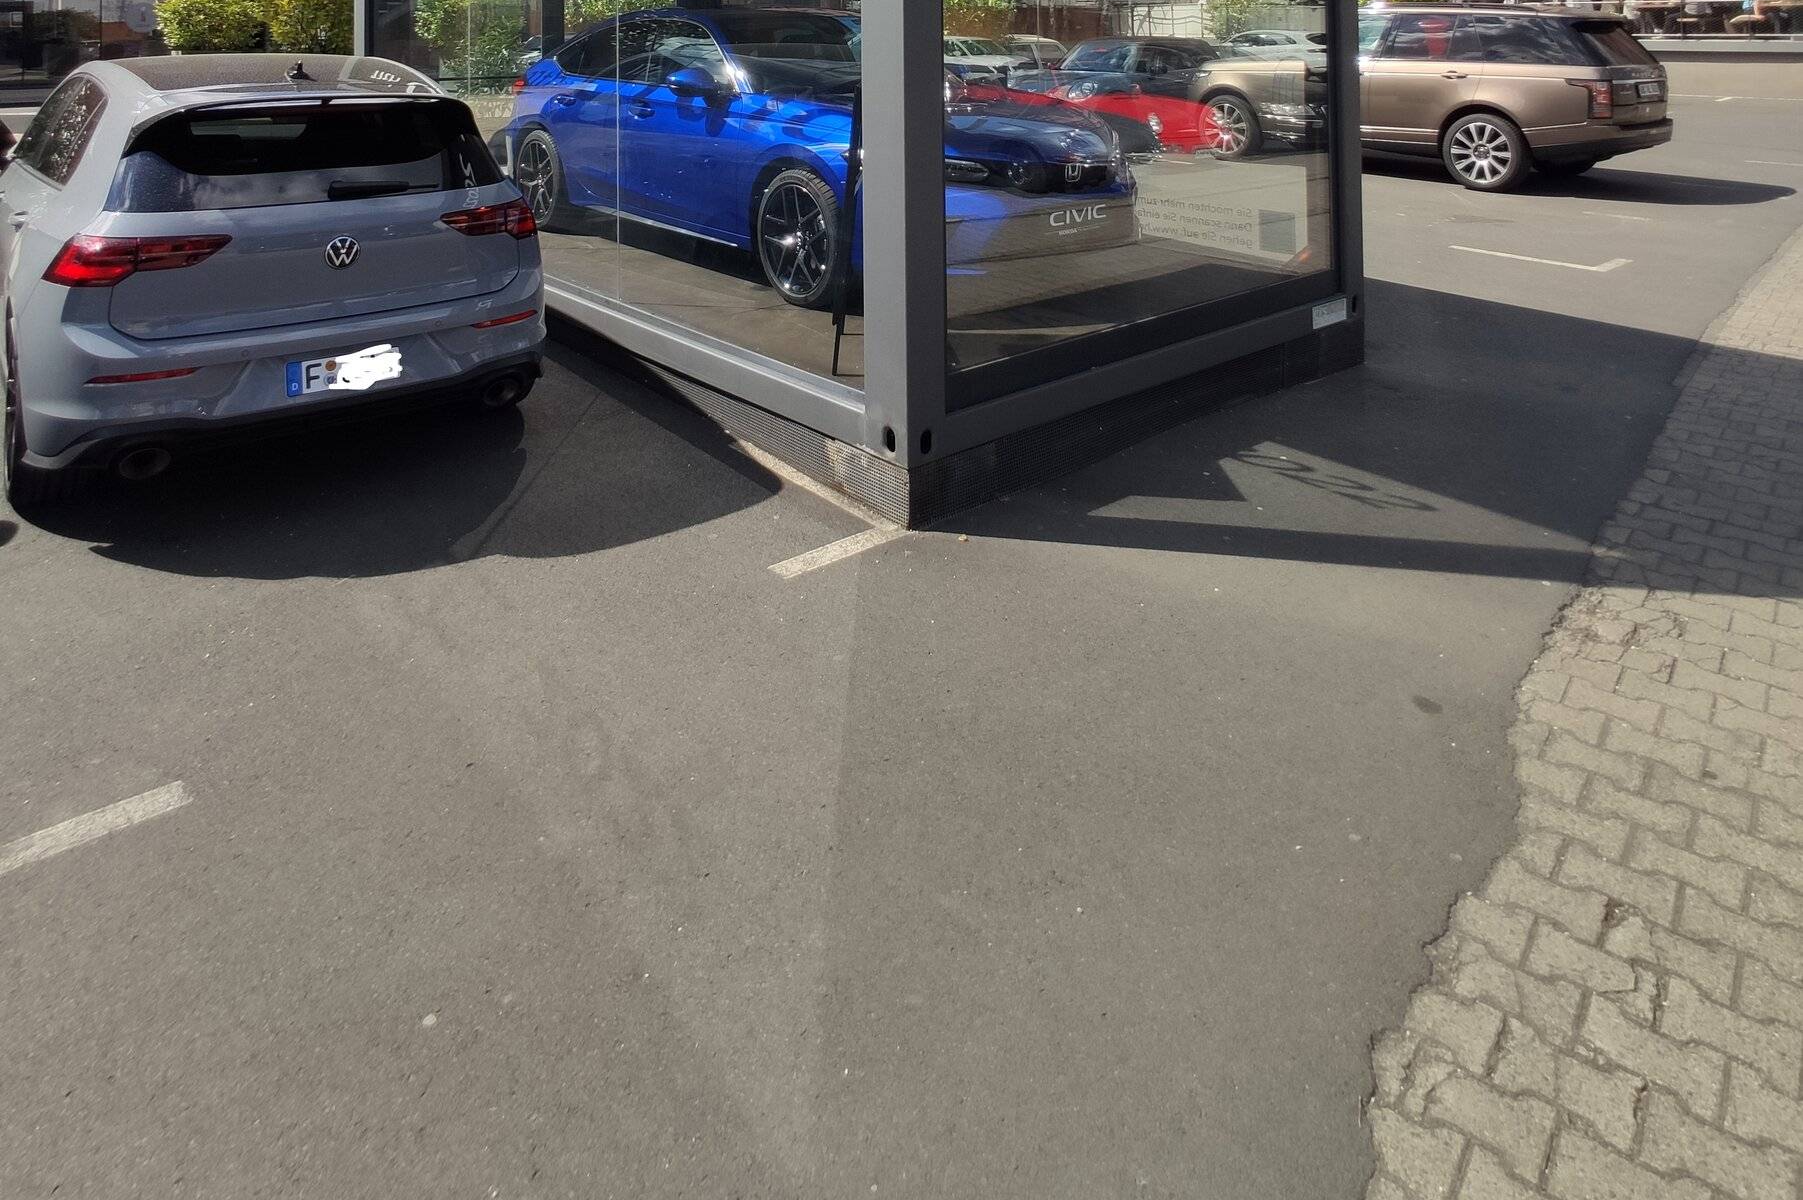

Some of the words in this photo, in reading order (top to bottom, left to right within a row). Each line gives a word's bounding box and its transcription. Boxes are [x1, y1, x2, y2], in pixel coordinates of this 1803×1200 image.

[1049, 204, 1107, 227] CIVIC
[291, 382, 299, 391] D
[305, 362, 322, 389] F
